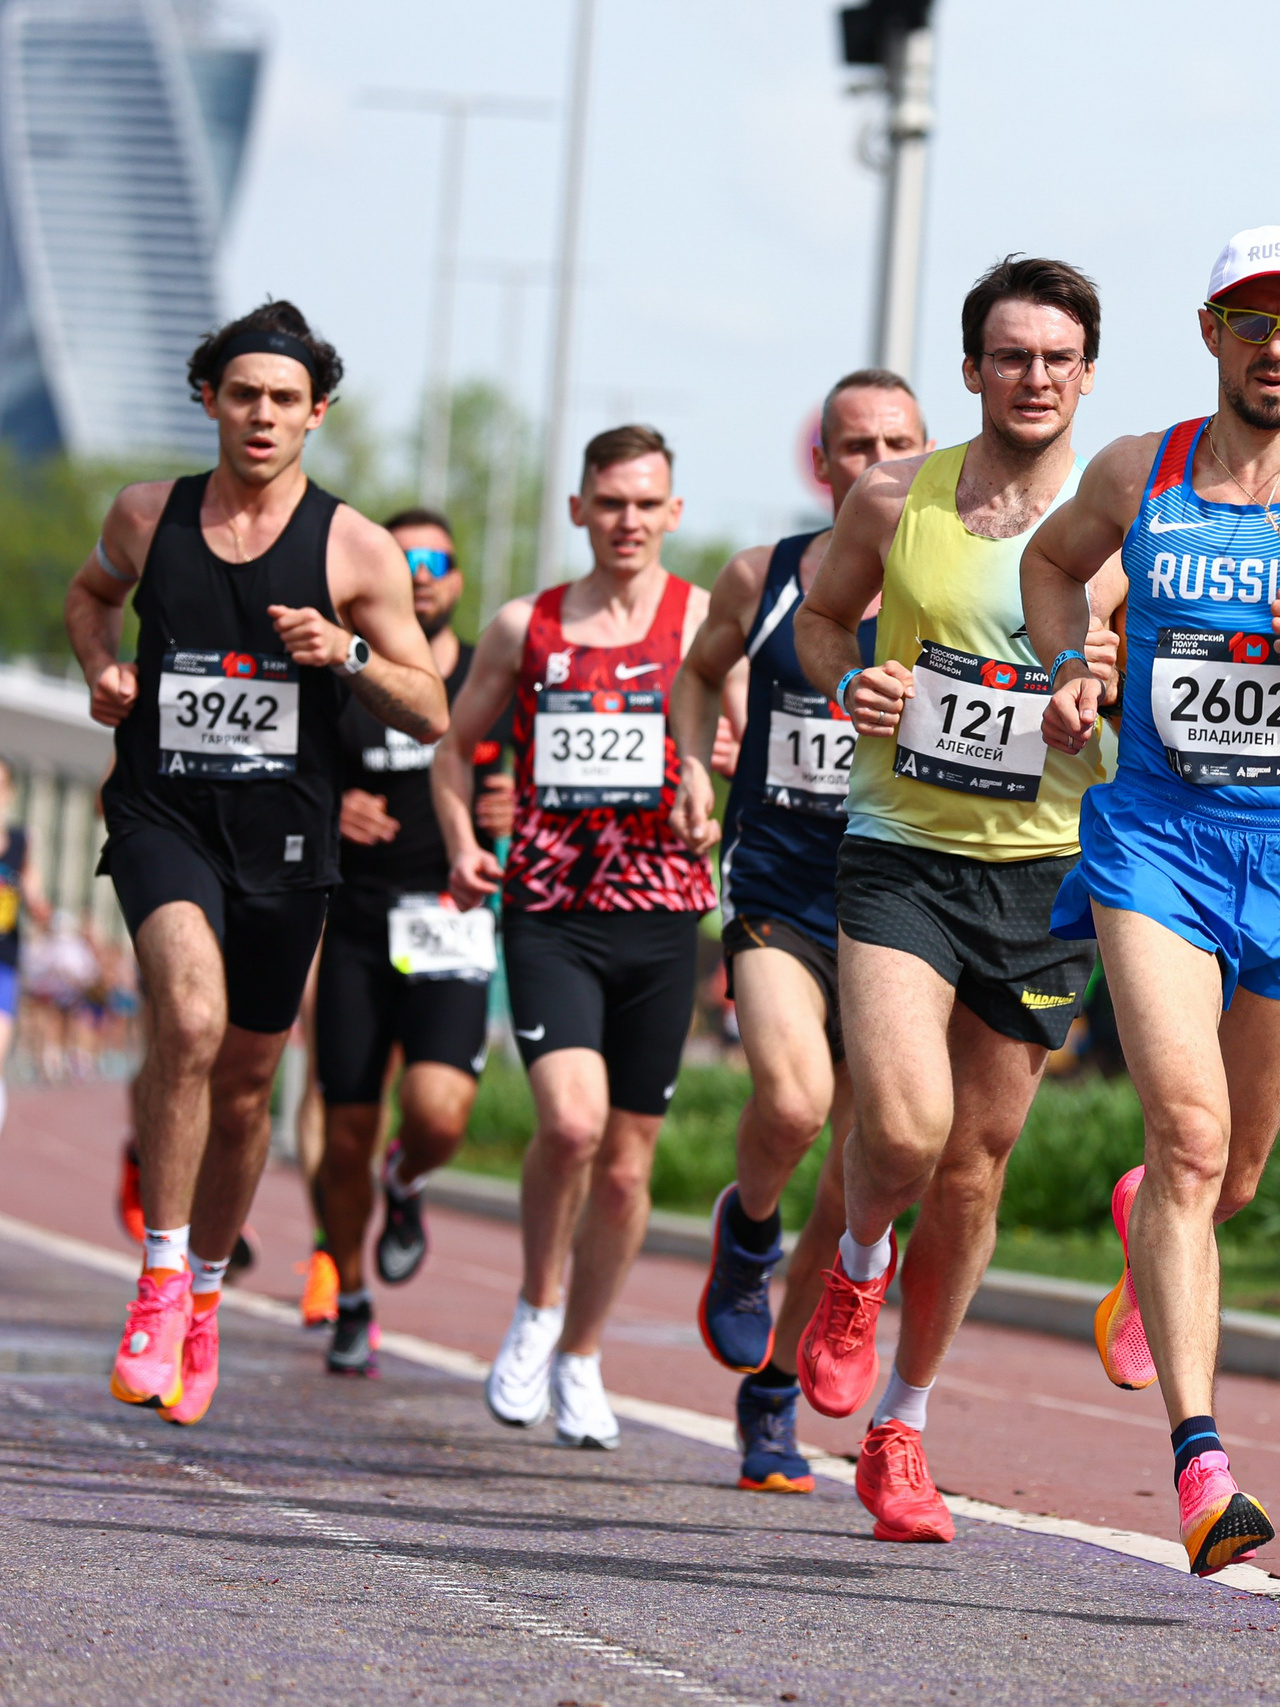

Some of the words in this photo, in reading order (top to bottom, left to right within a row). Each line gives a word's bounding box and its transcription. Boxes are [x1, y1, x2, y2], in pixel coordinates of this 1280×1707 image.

[1172, 632, 1225, 643] МОСКОВСКИЙ
[930, 646, 979, 668] МОСКОВСКИЙ
[1171, 648, 1209, 657] МАРАФОН
[928, 660, 962, 676] МАРАФОН
[1024, 671, 1032, 681] 5
[1023, 683, 1048, 691] 2024
[176, 690, 279, 732] 3942
[940, 693, 1016, 746] 121
[551, 728, 645, 762] 3322
[1187, 727, 1275, 746] ВЛАДИЛЕН
[935, 738, 1004, 762] АЛЕКСЕЙ
[169, 752, 187, 774] A
[901, 753, 918, 778] A
